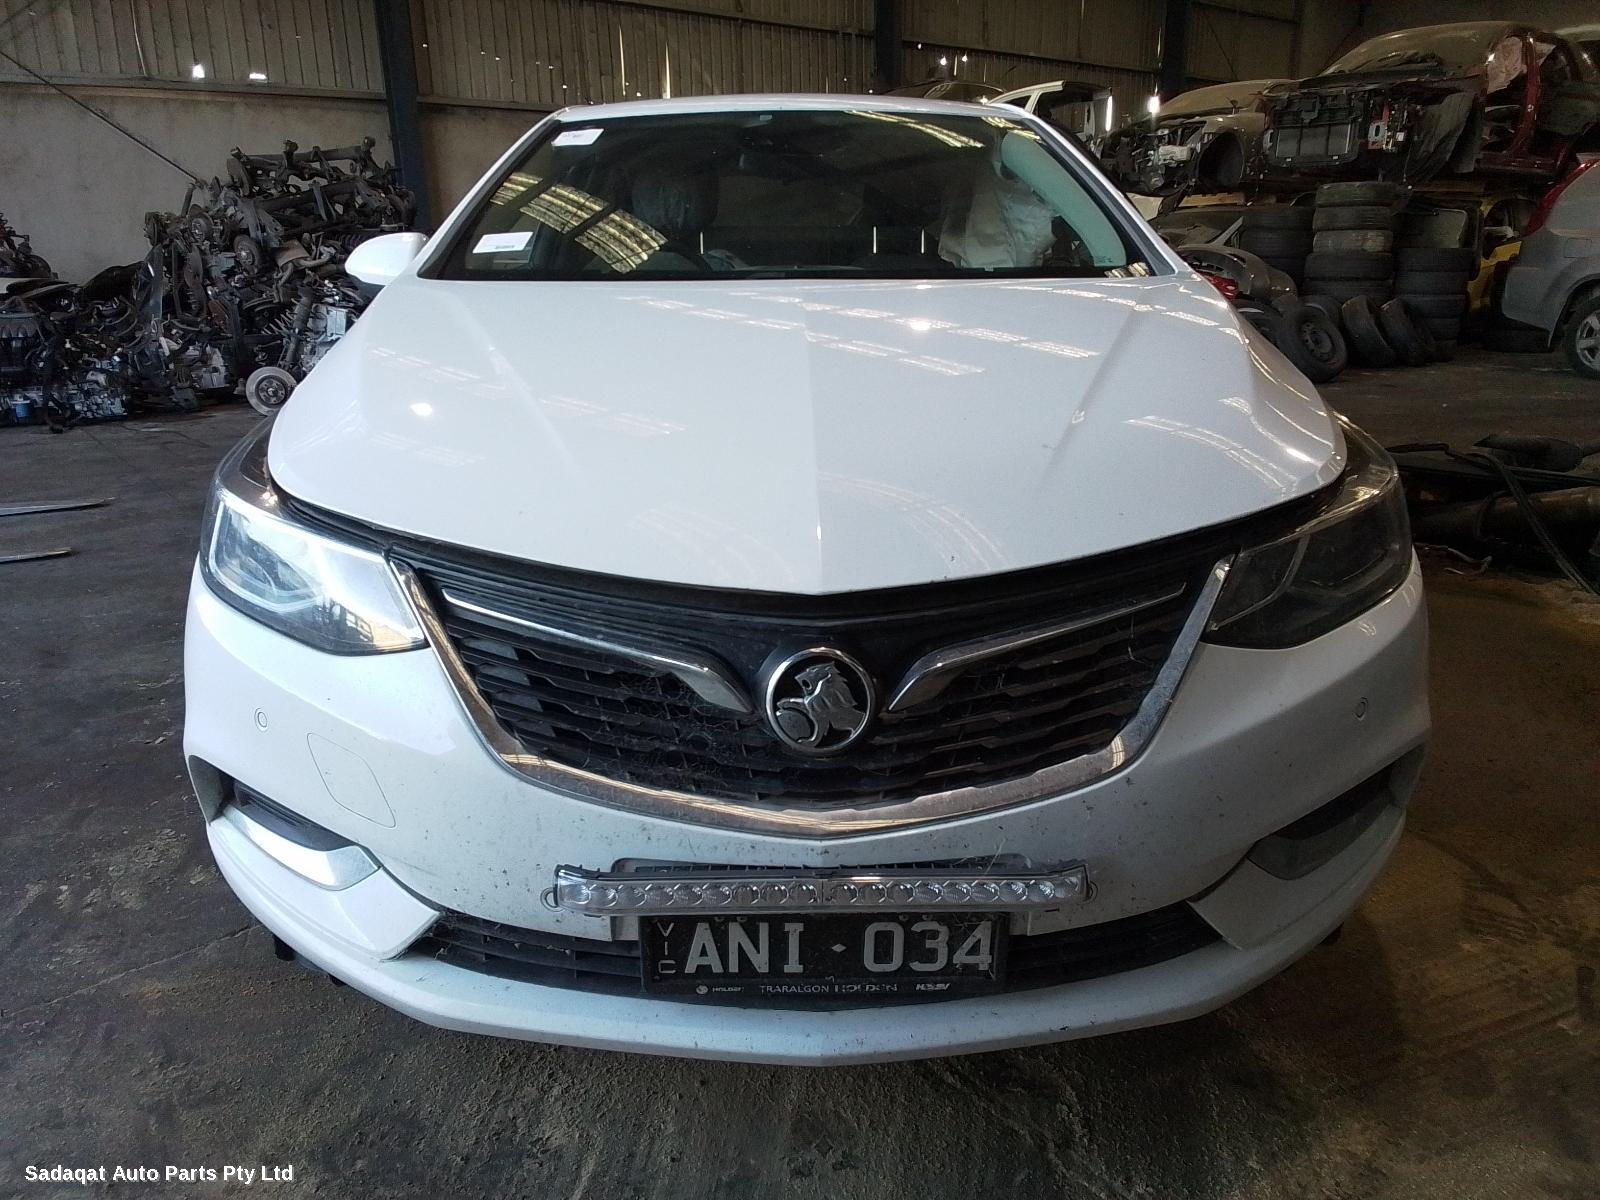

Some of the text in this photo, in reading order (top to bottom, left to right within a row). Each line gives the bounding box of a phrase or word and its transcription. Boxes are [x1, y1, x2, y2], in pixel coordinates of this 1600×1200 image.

[656, 921, 677, 974] VIC
[684, 920, 993, 974] ANI 034
[759, 985, 830, 994] TRARALGON
